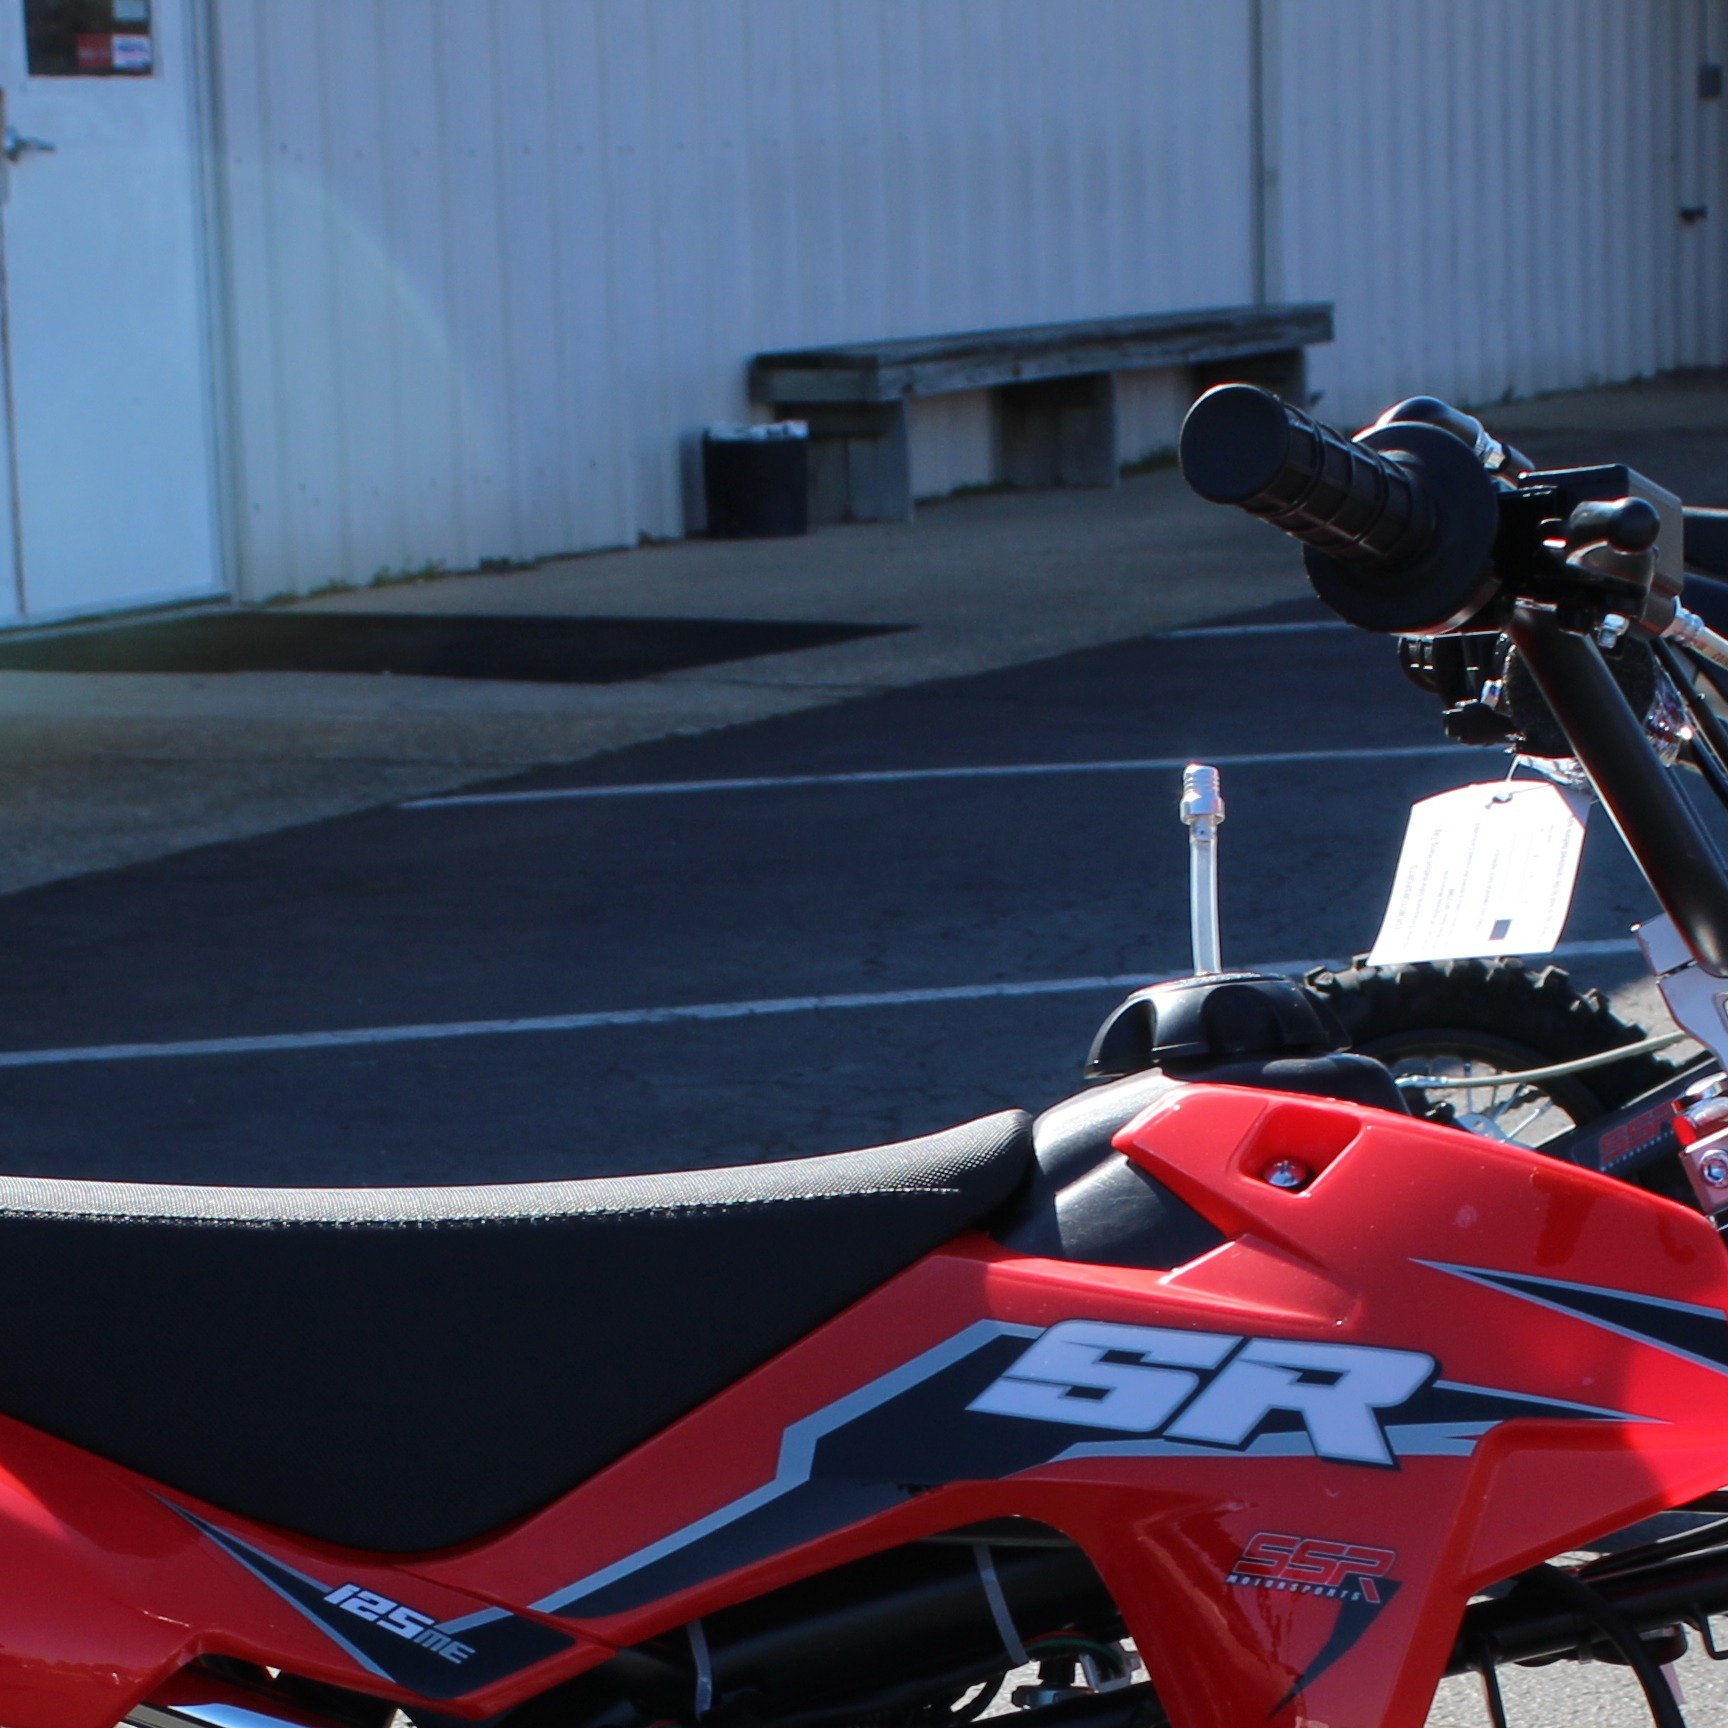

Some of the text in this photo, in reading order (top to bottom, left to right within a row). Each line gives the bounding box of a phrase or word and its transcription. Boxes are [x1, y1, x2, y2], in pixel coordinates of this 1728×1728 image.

[965, 1319, 1438, 1466] SR
[1226, 1575, 1362, 1601] MOTORSPORTS
[1233, 1532, 1397, 1603] SSR
